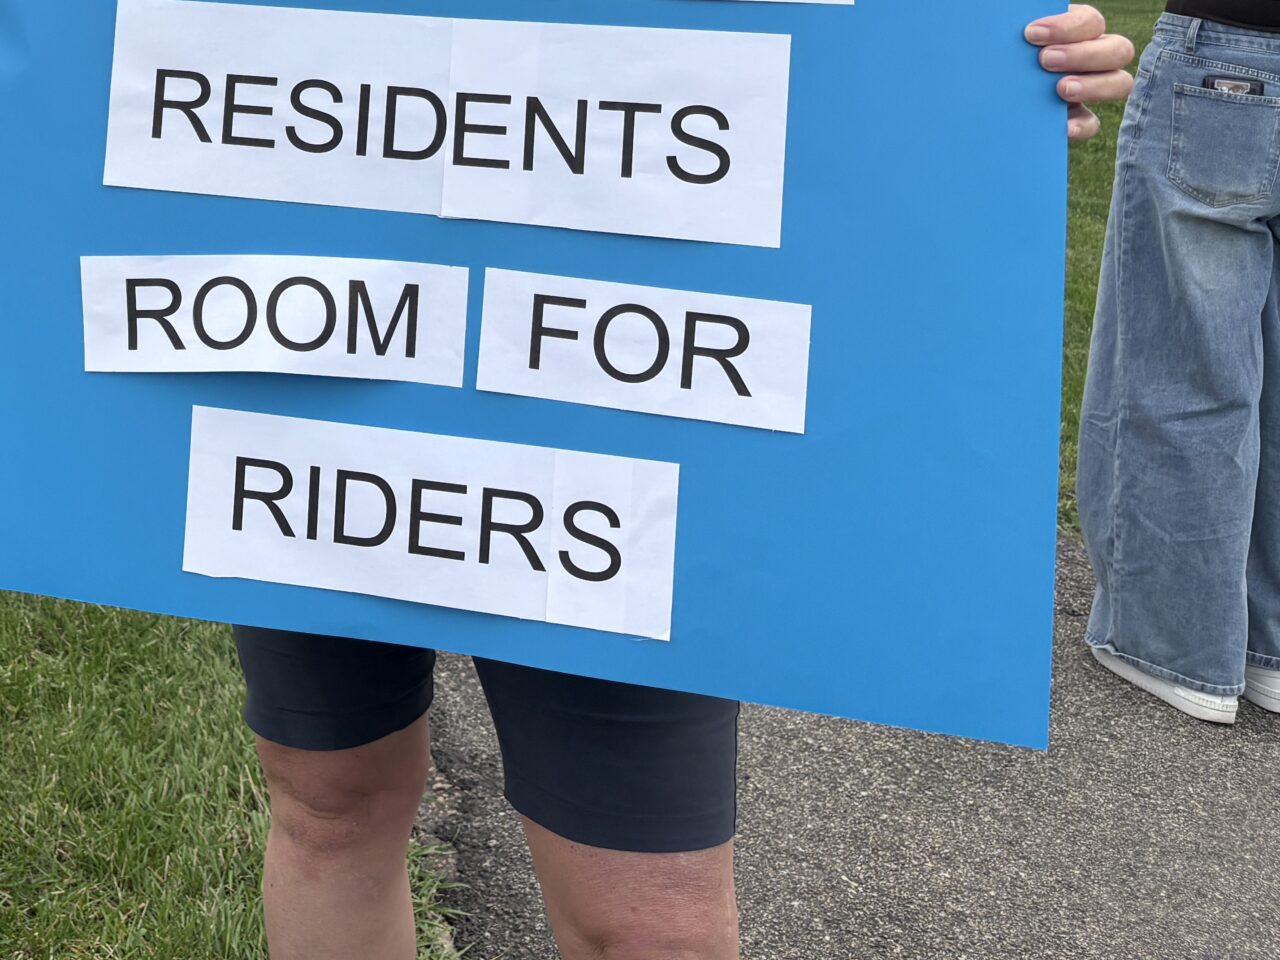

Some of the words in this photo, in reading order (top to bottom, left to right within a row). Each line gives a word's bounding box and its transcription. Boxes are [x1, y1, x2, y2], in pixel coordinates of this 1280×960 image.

[151, 68, 731, 185] RESIDENTS
[125, 276, 419, 358] ROOM
[529, 293, 752, 397] FOR
[232, 456, 622, 582] RIDERS
